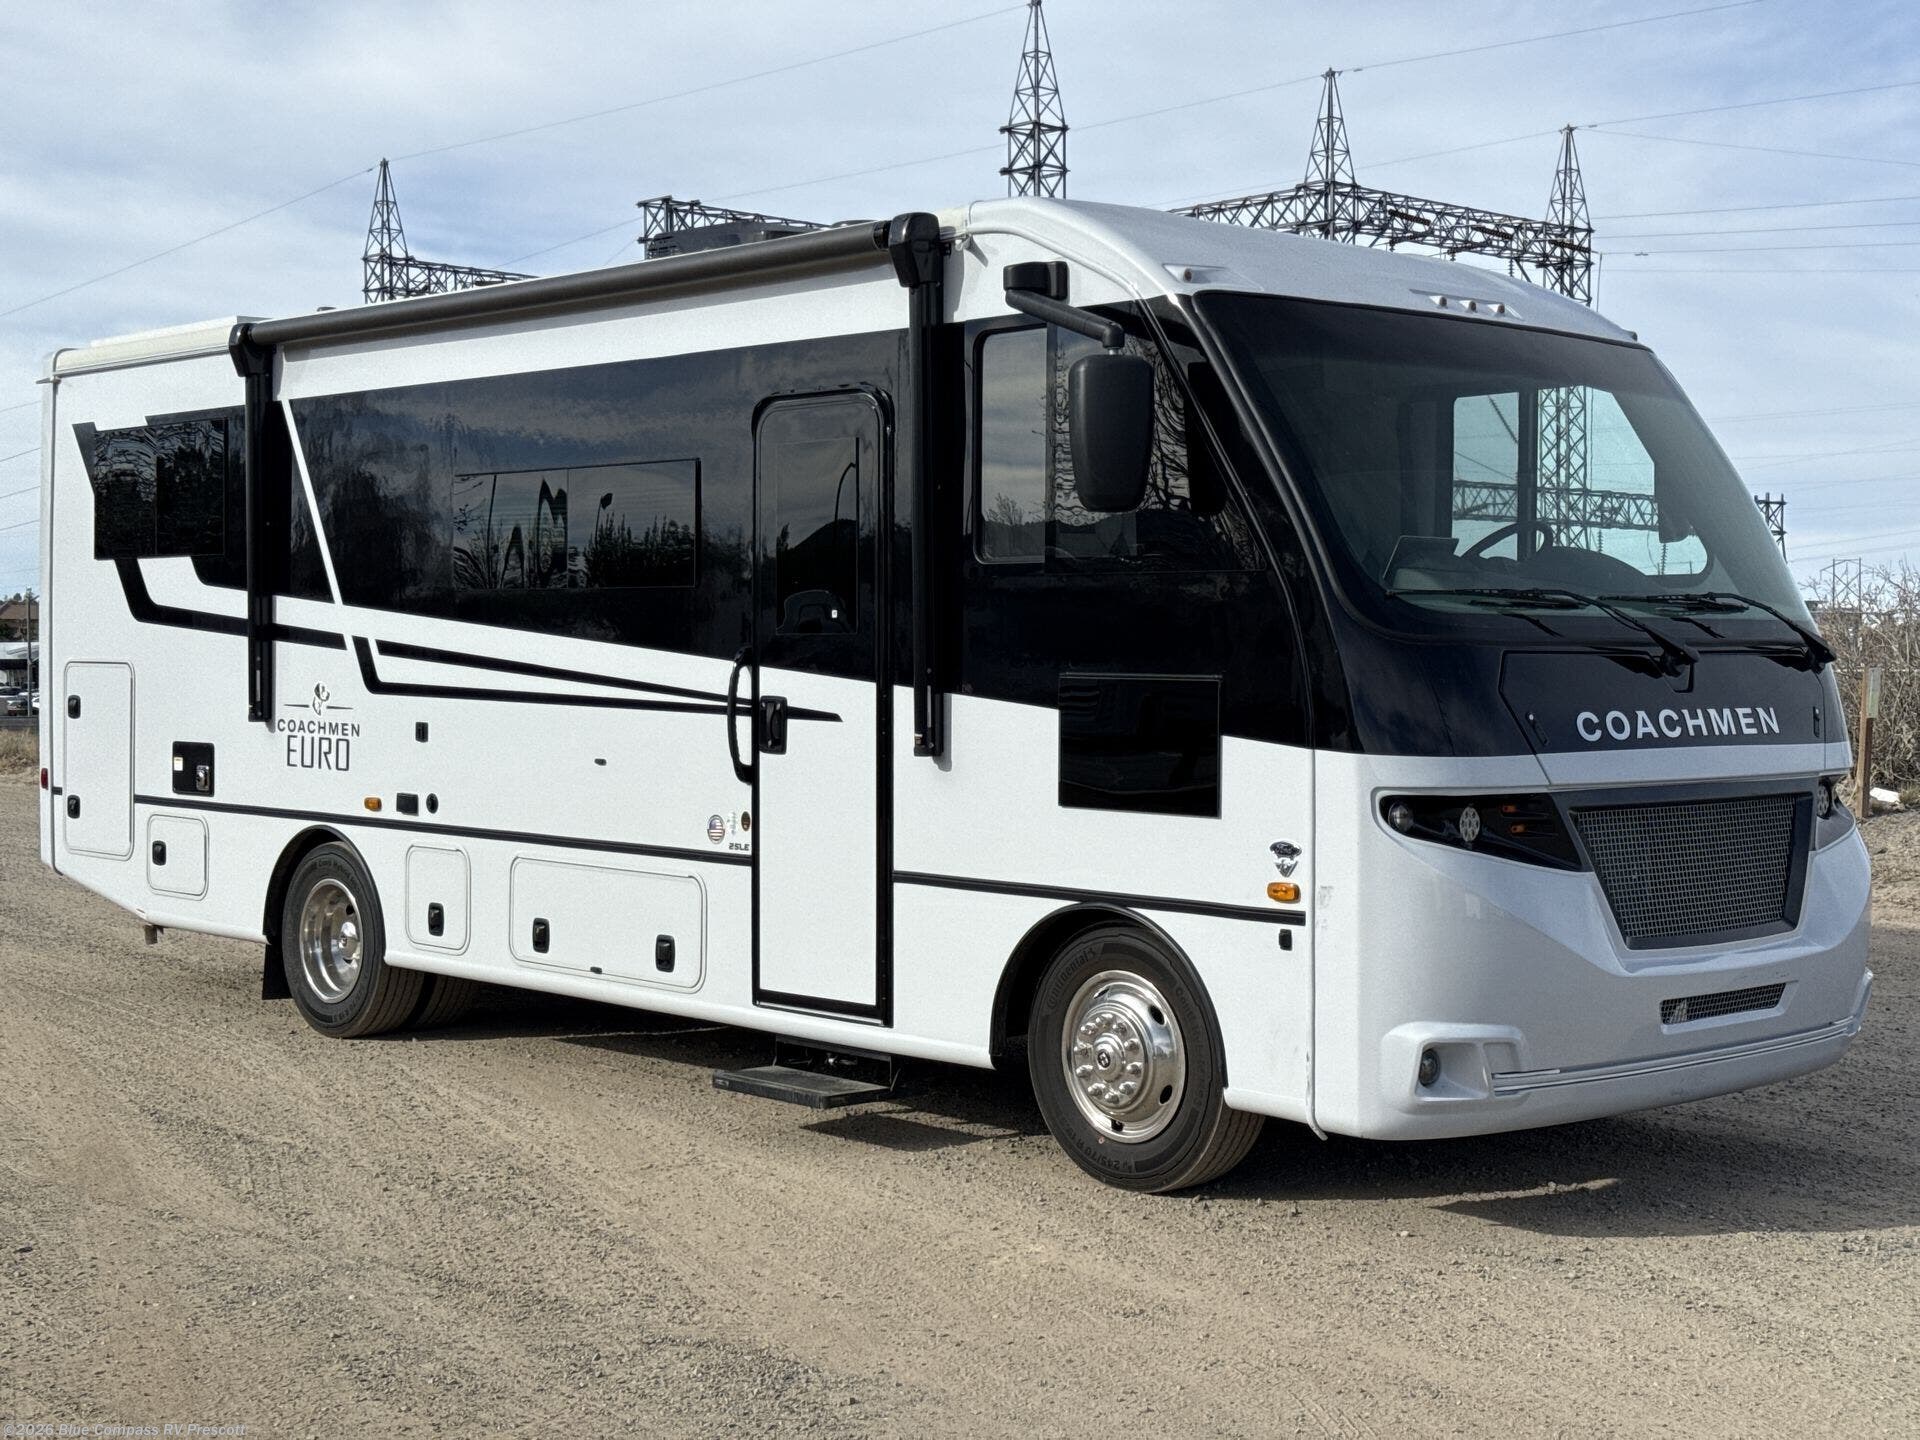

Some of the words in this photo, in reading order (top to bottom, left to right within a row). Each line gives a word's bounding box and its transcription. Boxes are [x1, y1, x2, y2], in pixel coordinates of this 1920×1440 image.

[278, 719, 360, 737] COACHMEN
[1577, 707, 1780, 742] COACHMEN
[287, 734, 350, 771] EURO
